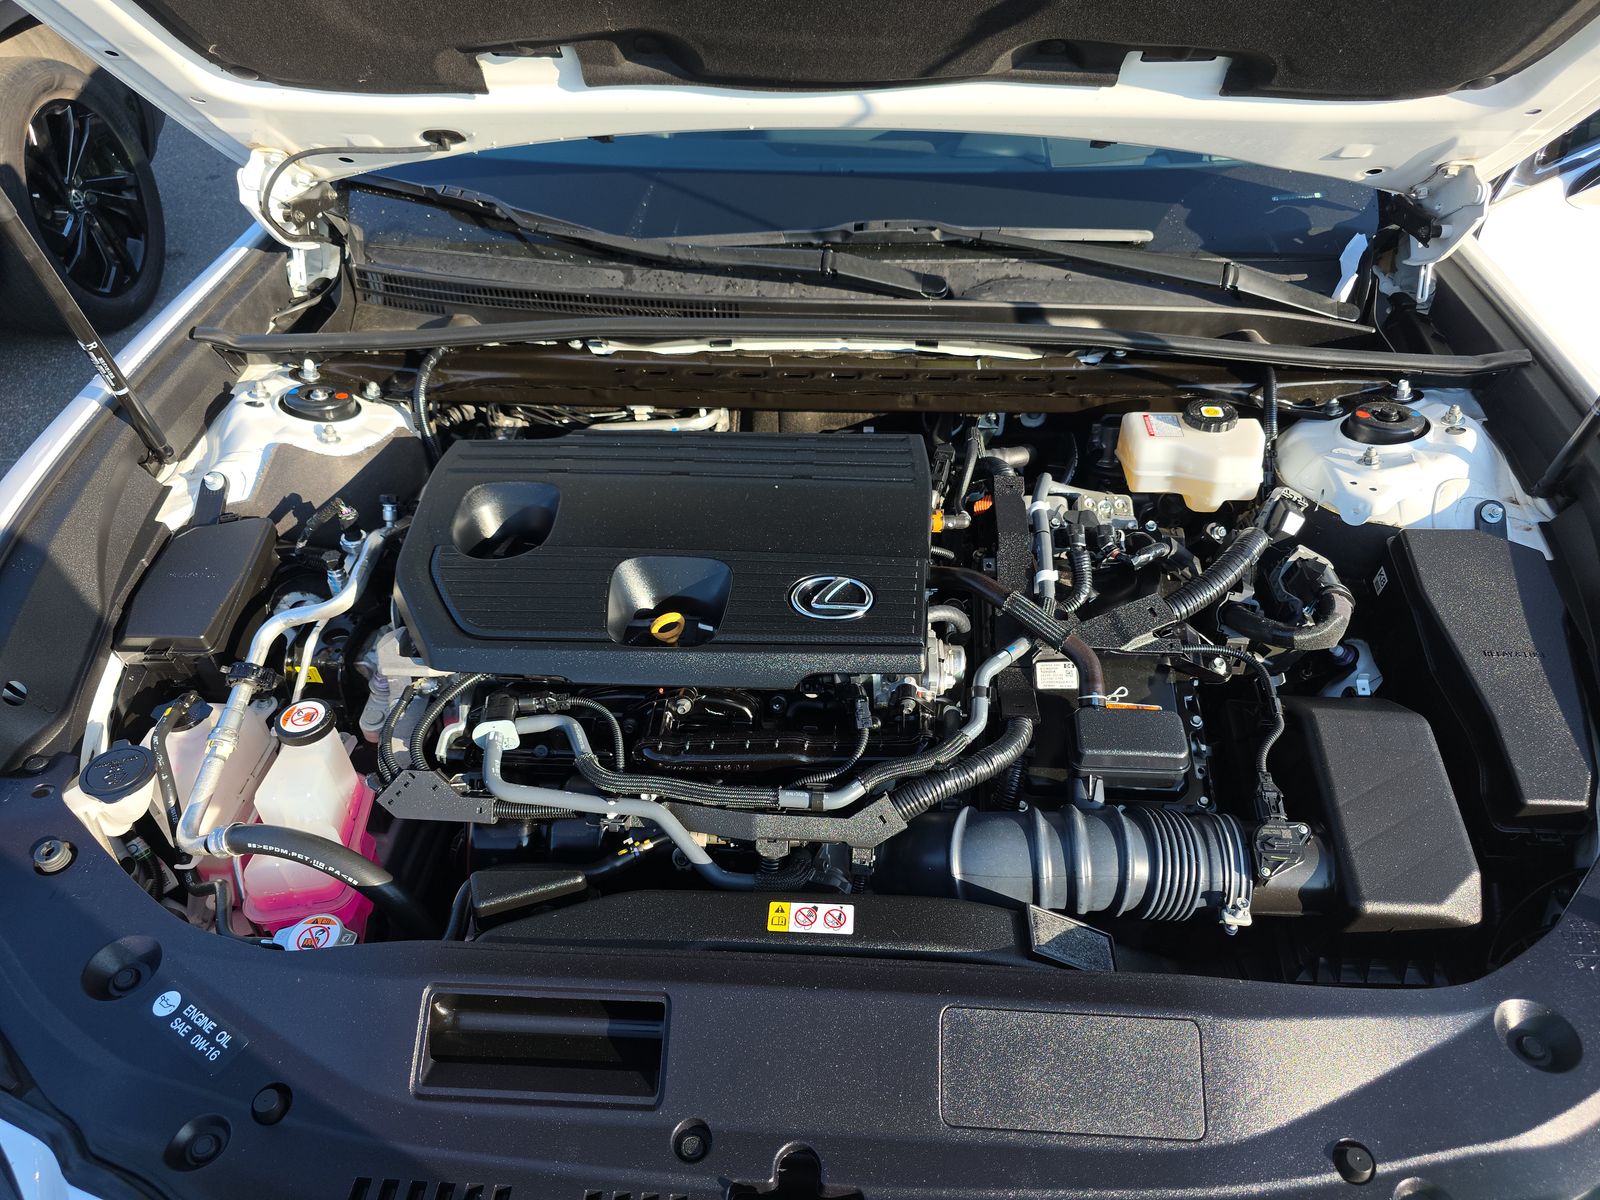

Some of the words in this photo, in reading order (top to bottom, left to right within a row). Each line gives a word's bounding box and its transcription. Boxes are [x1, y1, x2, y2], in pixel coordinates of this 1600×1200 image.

[170, 1017, 192, 1037] SAE
[190, 1034, 220, 1061] 0W-16
[182, 1004, 217, 1034] ENGINE
[215, 1031, 232, 1049] OIL
